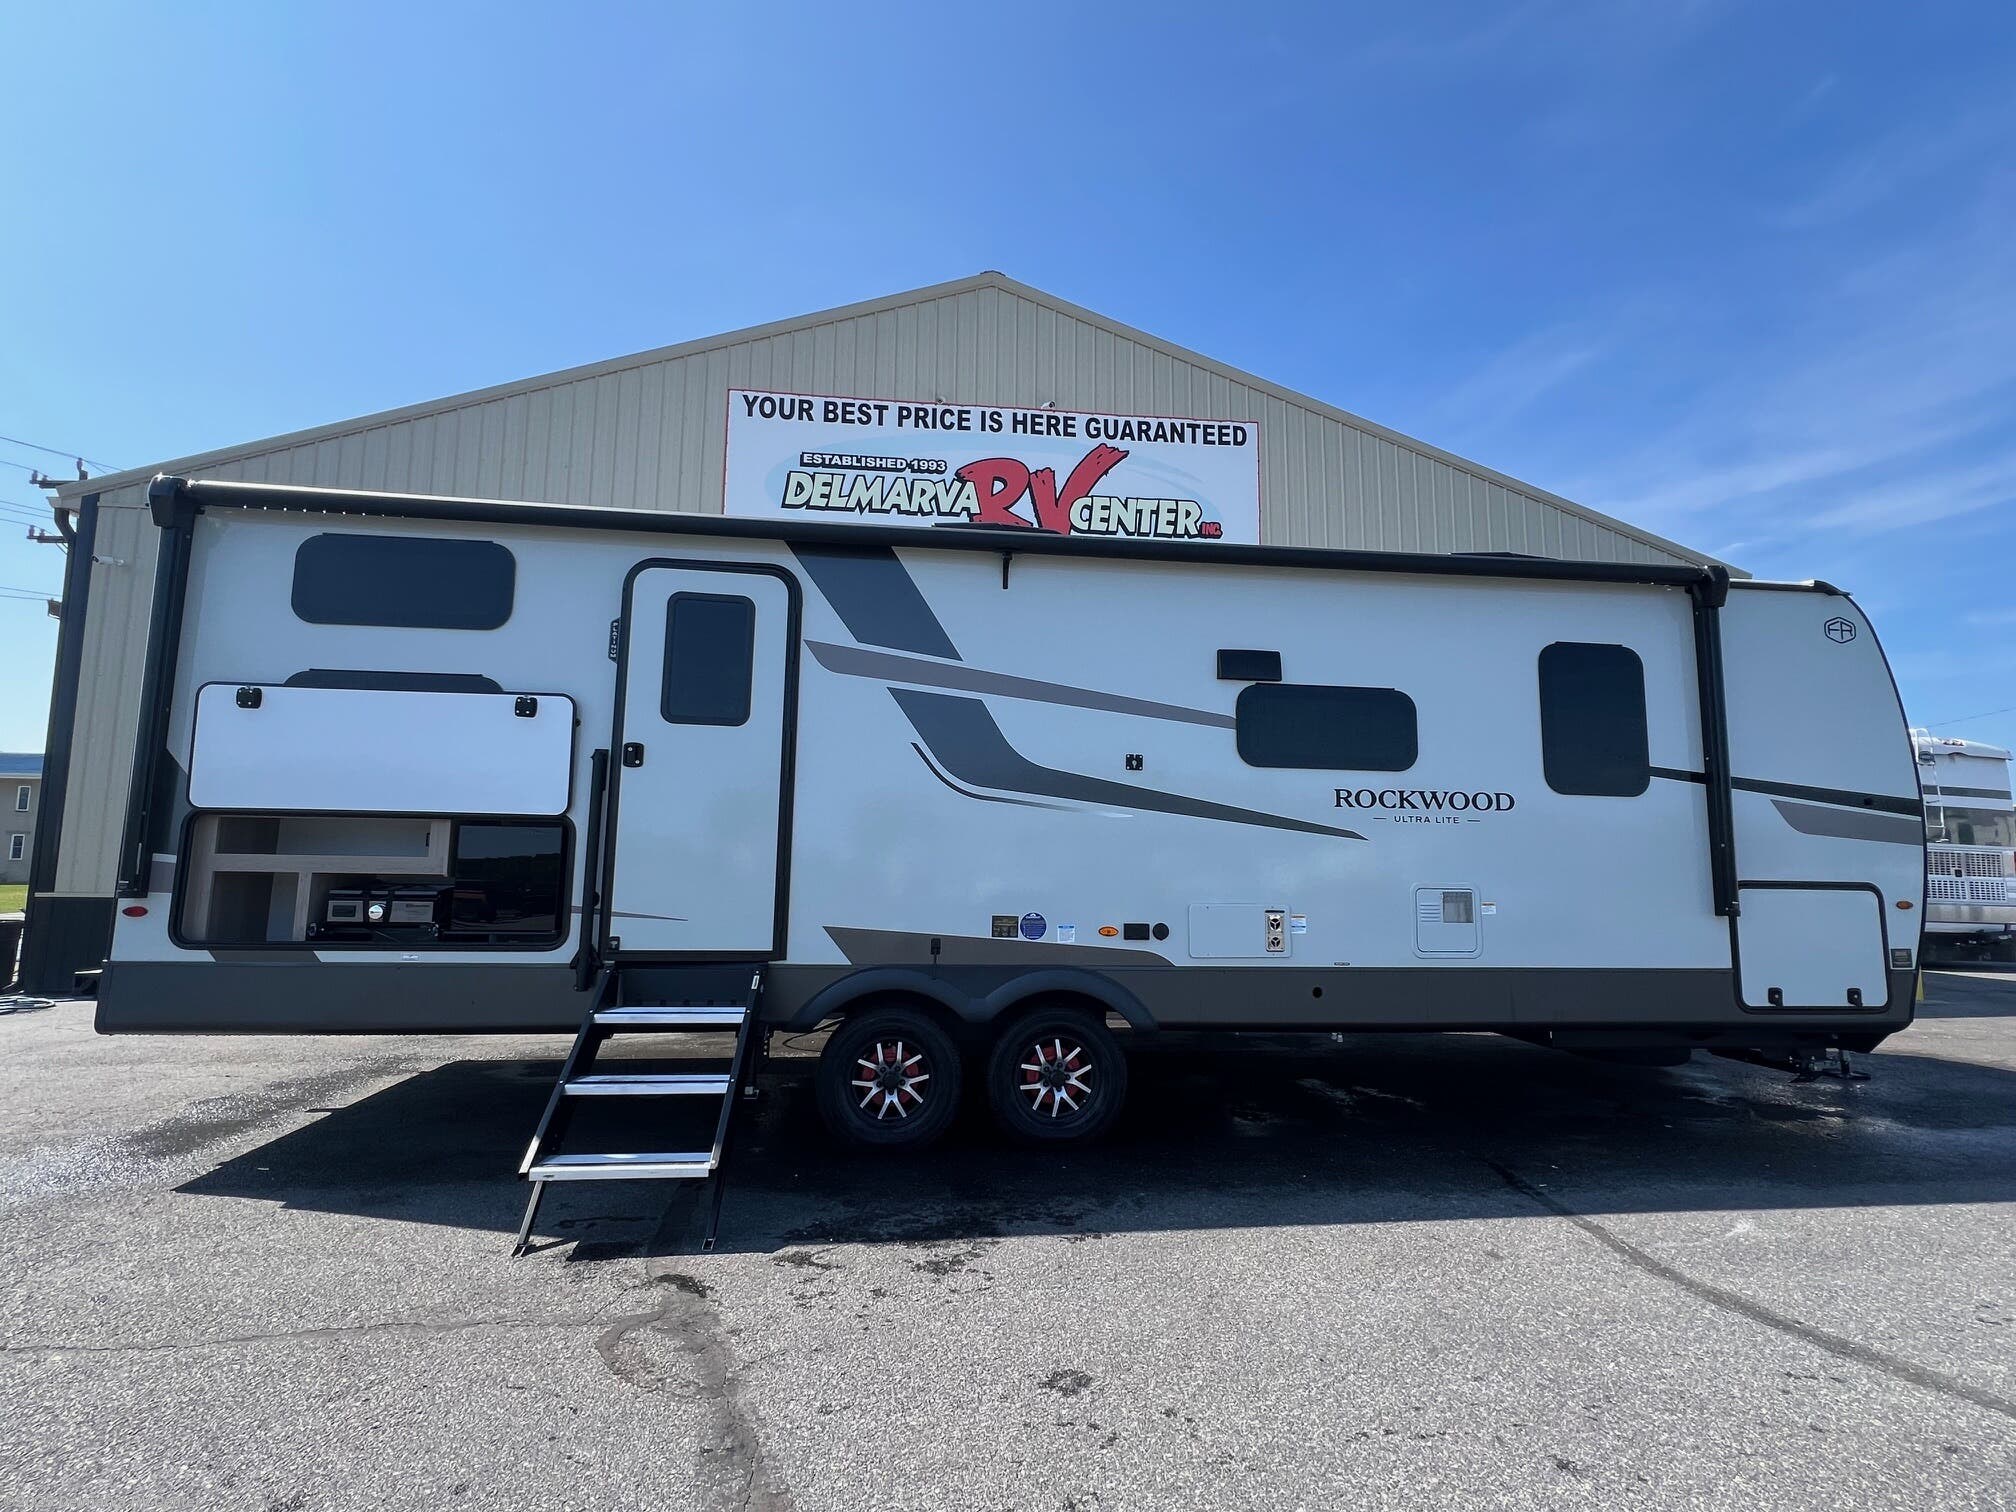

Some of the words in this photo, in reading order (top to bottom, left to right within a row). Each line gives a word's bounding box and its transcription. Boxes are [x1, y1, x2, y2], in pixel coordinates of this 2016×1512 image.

[742, 394, 815, 422] YOUR
[823, 400, 889, 427] BEST
[897, 405, 972, 432] PRICE
[980, 410, 1003, 433] IS
[1012, 412, 1077, 438] HERE
[1085, 417, 1248, 447] GUARANTEED
[802, 453, 907, 470] ESTABLISHED
[911, 459, 947, 472] 1993
[782, 471, 982, 515] DELMARVA
[955, 443, 1130, 536] RV
[1069, 495, 1202, 538] CENTER
[1201, 522, 1222, 537] INC.
[610, 622, 618, 658] PLATINUM
[1334, 788, 1516, 812] ROCKWOOD
[1394, 815, 1431, 824] ULTRA
[1435, 816, 1460, 824] LITE
